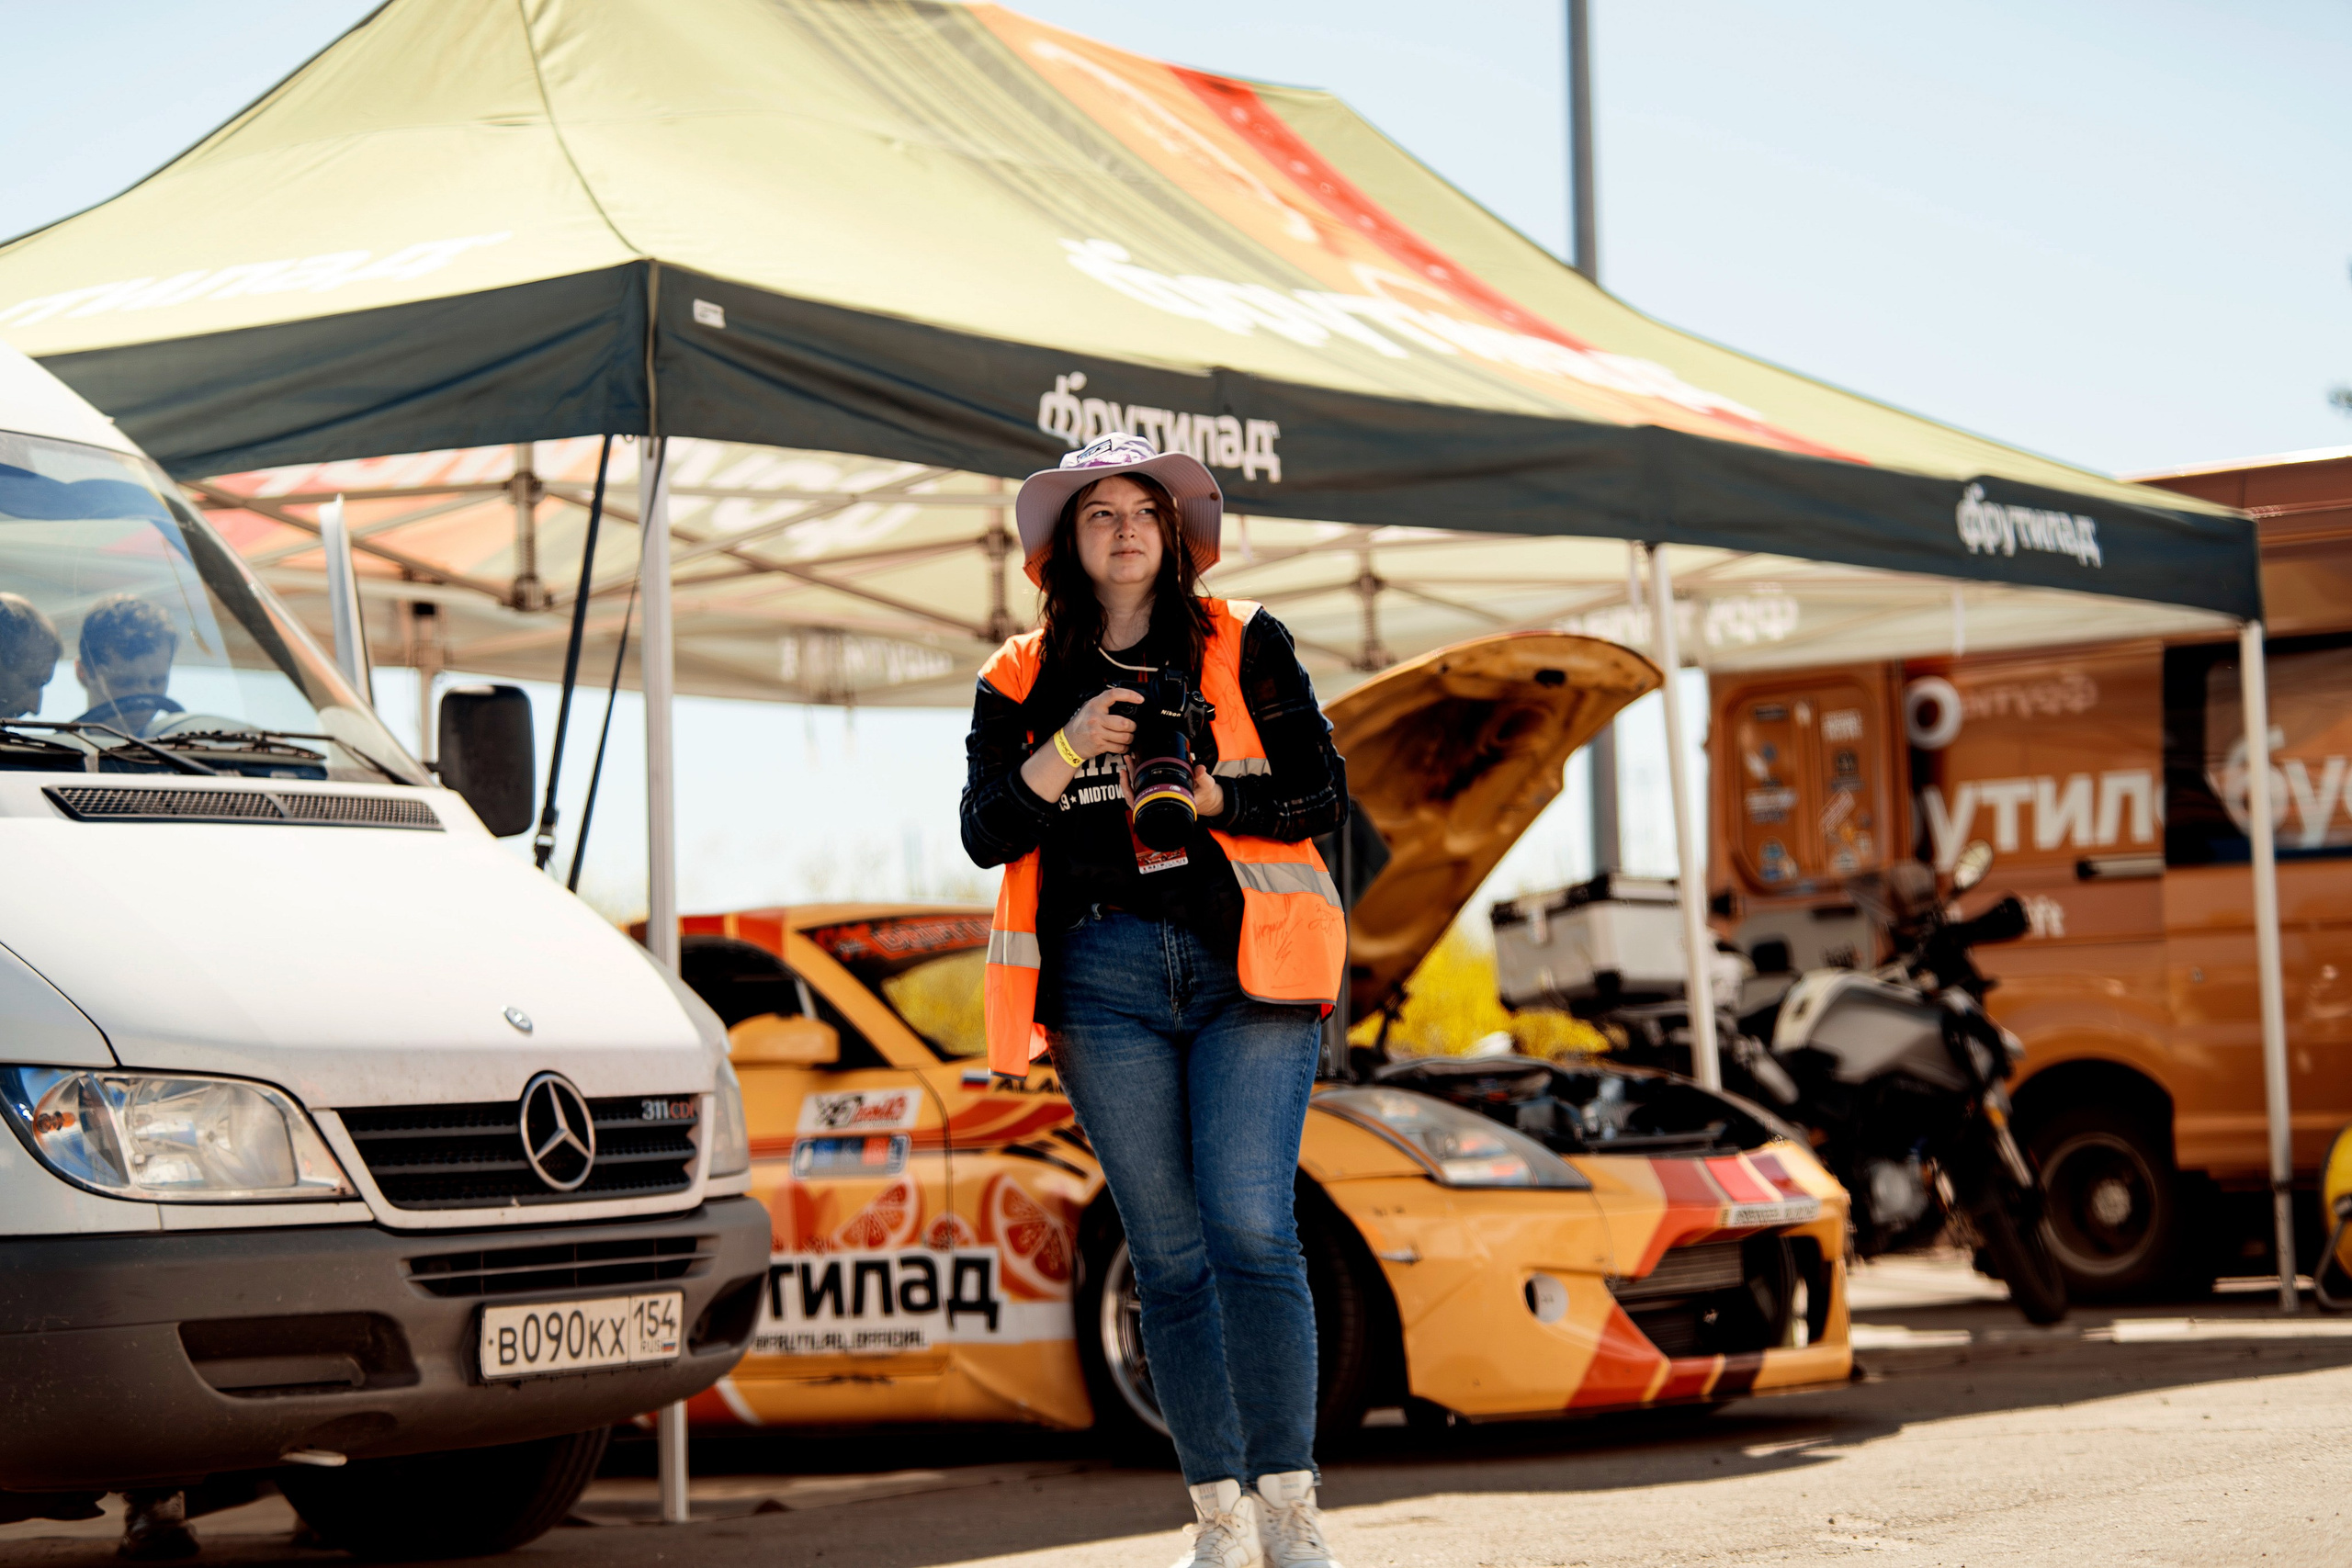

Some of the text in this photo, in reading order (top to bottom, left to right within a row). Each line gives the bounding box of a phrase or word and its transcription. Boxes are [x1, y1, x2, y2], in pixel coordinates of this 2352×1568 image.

[1160, 709, 1182, 717] Nikon
[1922, 769, 2165, 874] утил
[633, 1299, 676, 1337] 154
[640, 1337, 662, 1354] RUS
